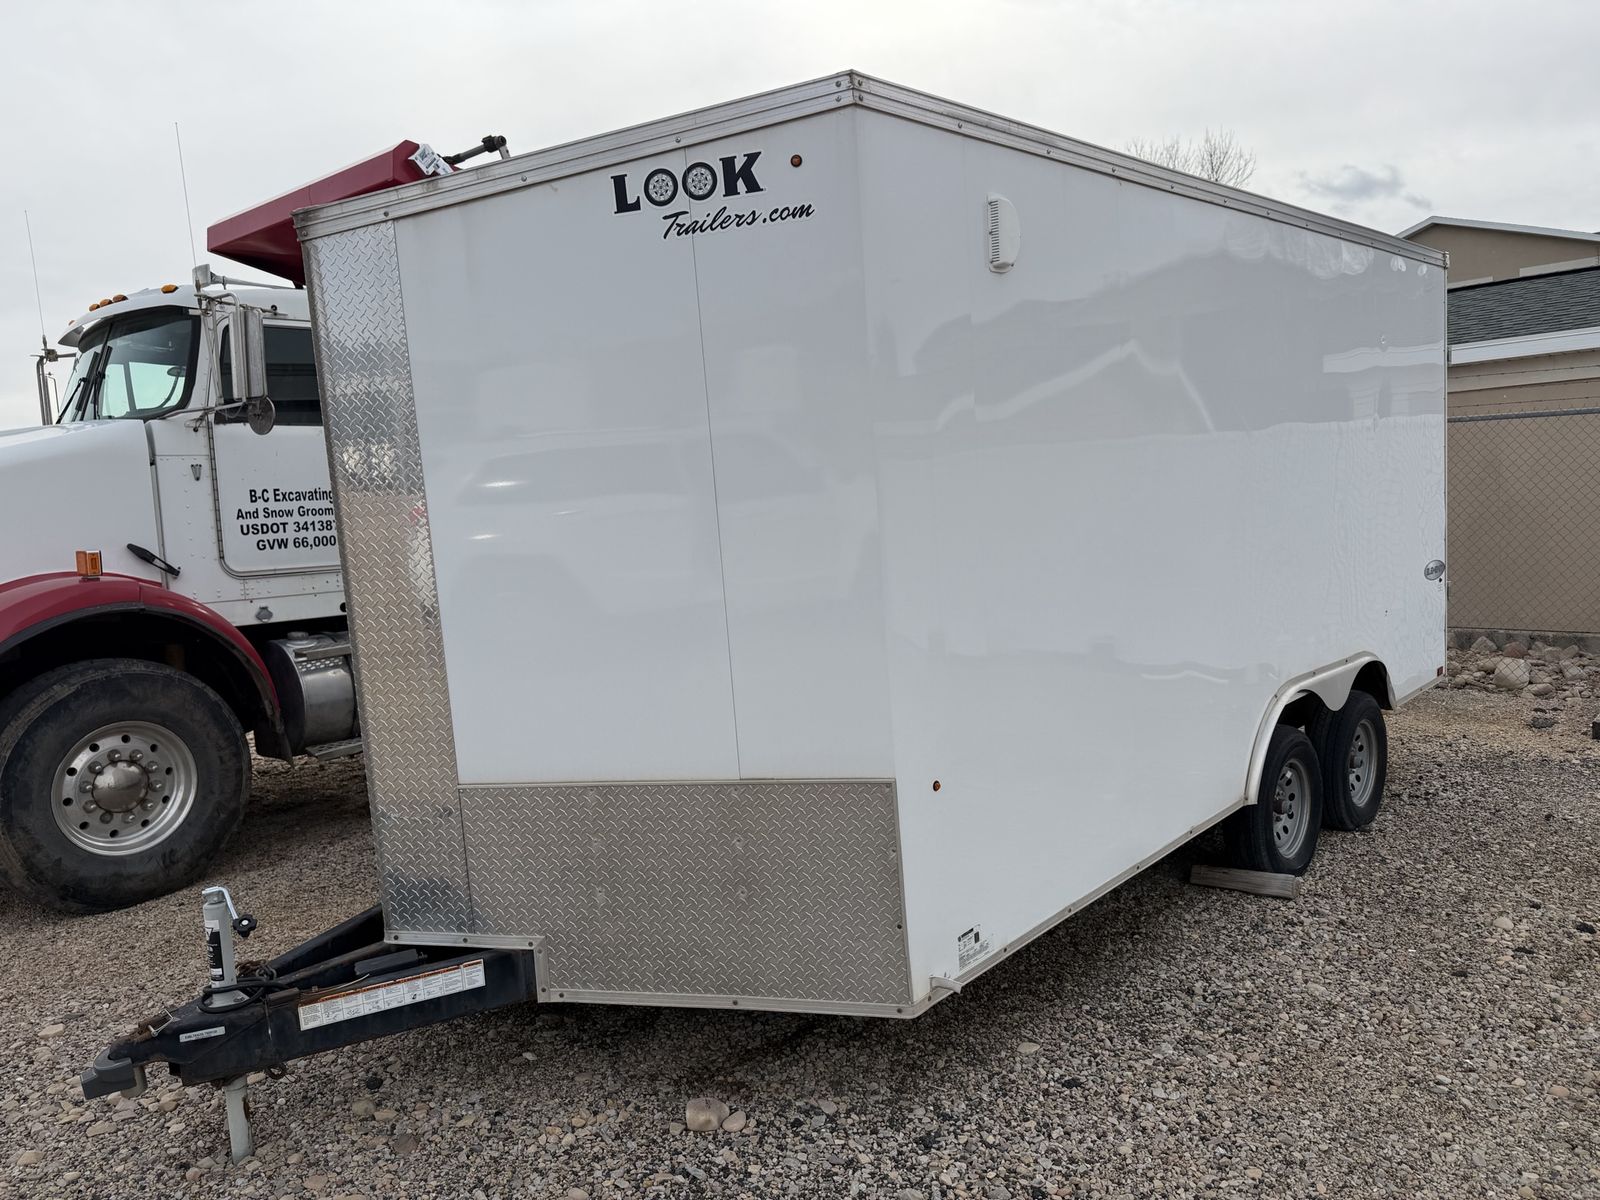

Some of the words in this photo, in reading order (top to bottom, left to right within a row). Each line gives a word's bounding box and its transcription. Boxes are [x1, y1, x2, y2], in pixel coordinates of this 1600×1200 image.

[610, 151, 764, 214] LOOK
[661, 203, 815, 240] Trailers.com
[249, 488, 270, 504] B-C
[236, 507, 259, 520] And
[262, 506, 295, 519] Snow
[240, 521, 289, 536] USDOT
[256, 537, 289, 551] GVW
[293, 535, 337, 550] 66,000
